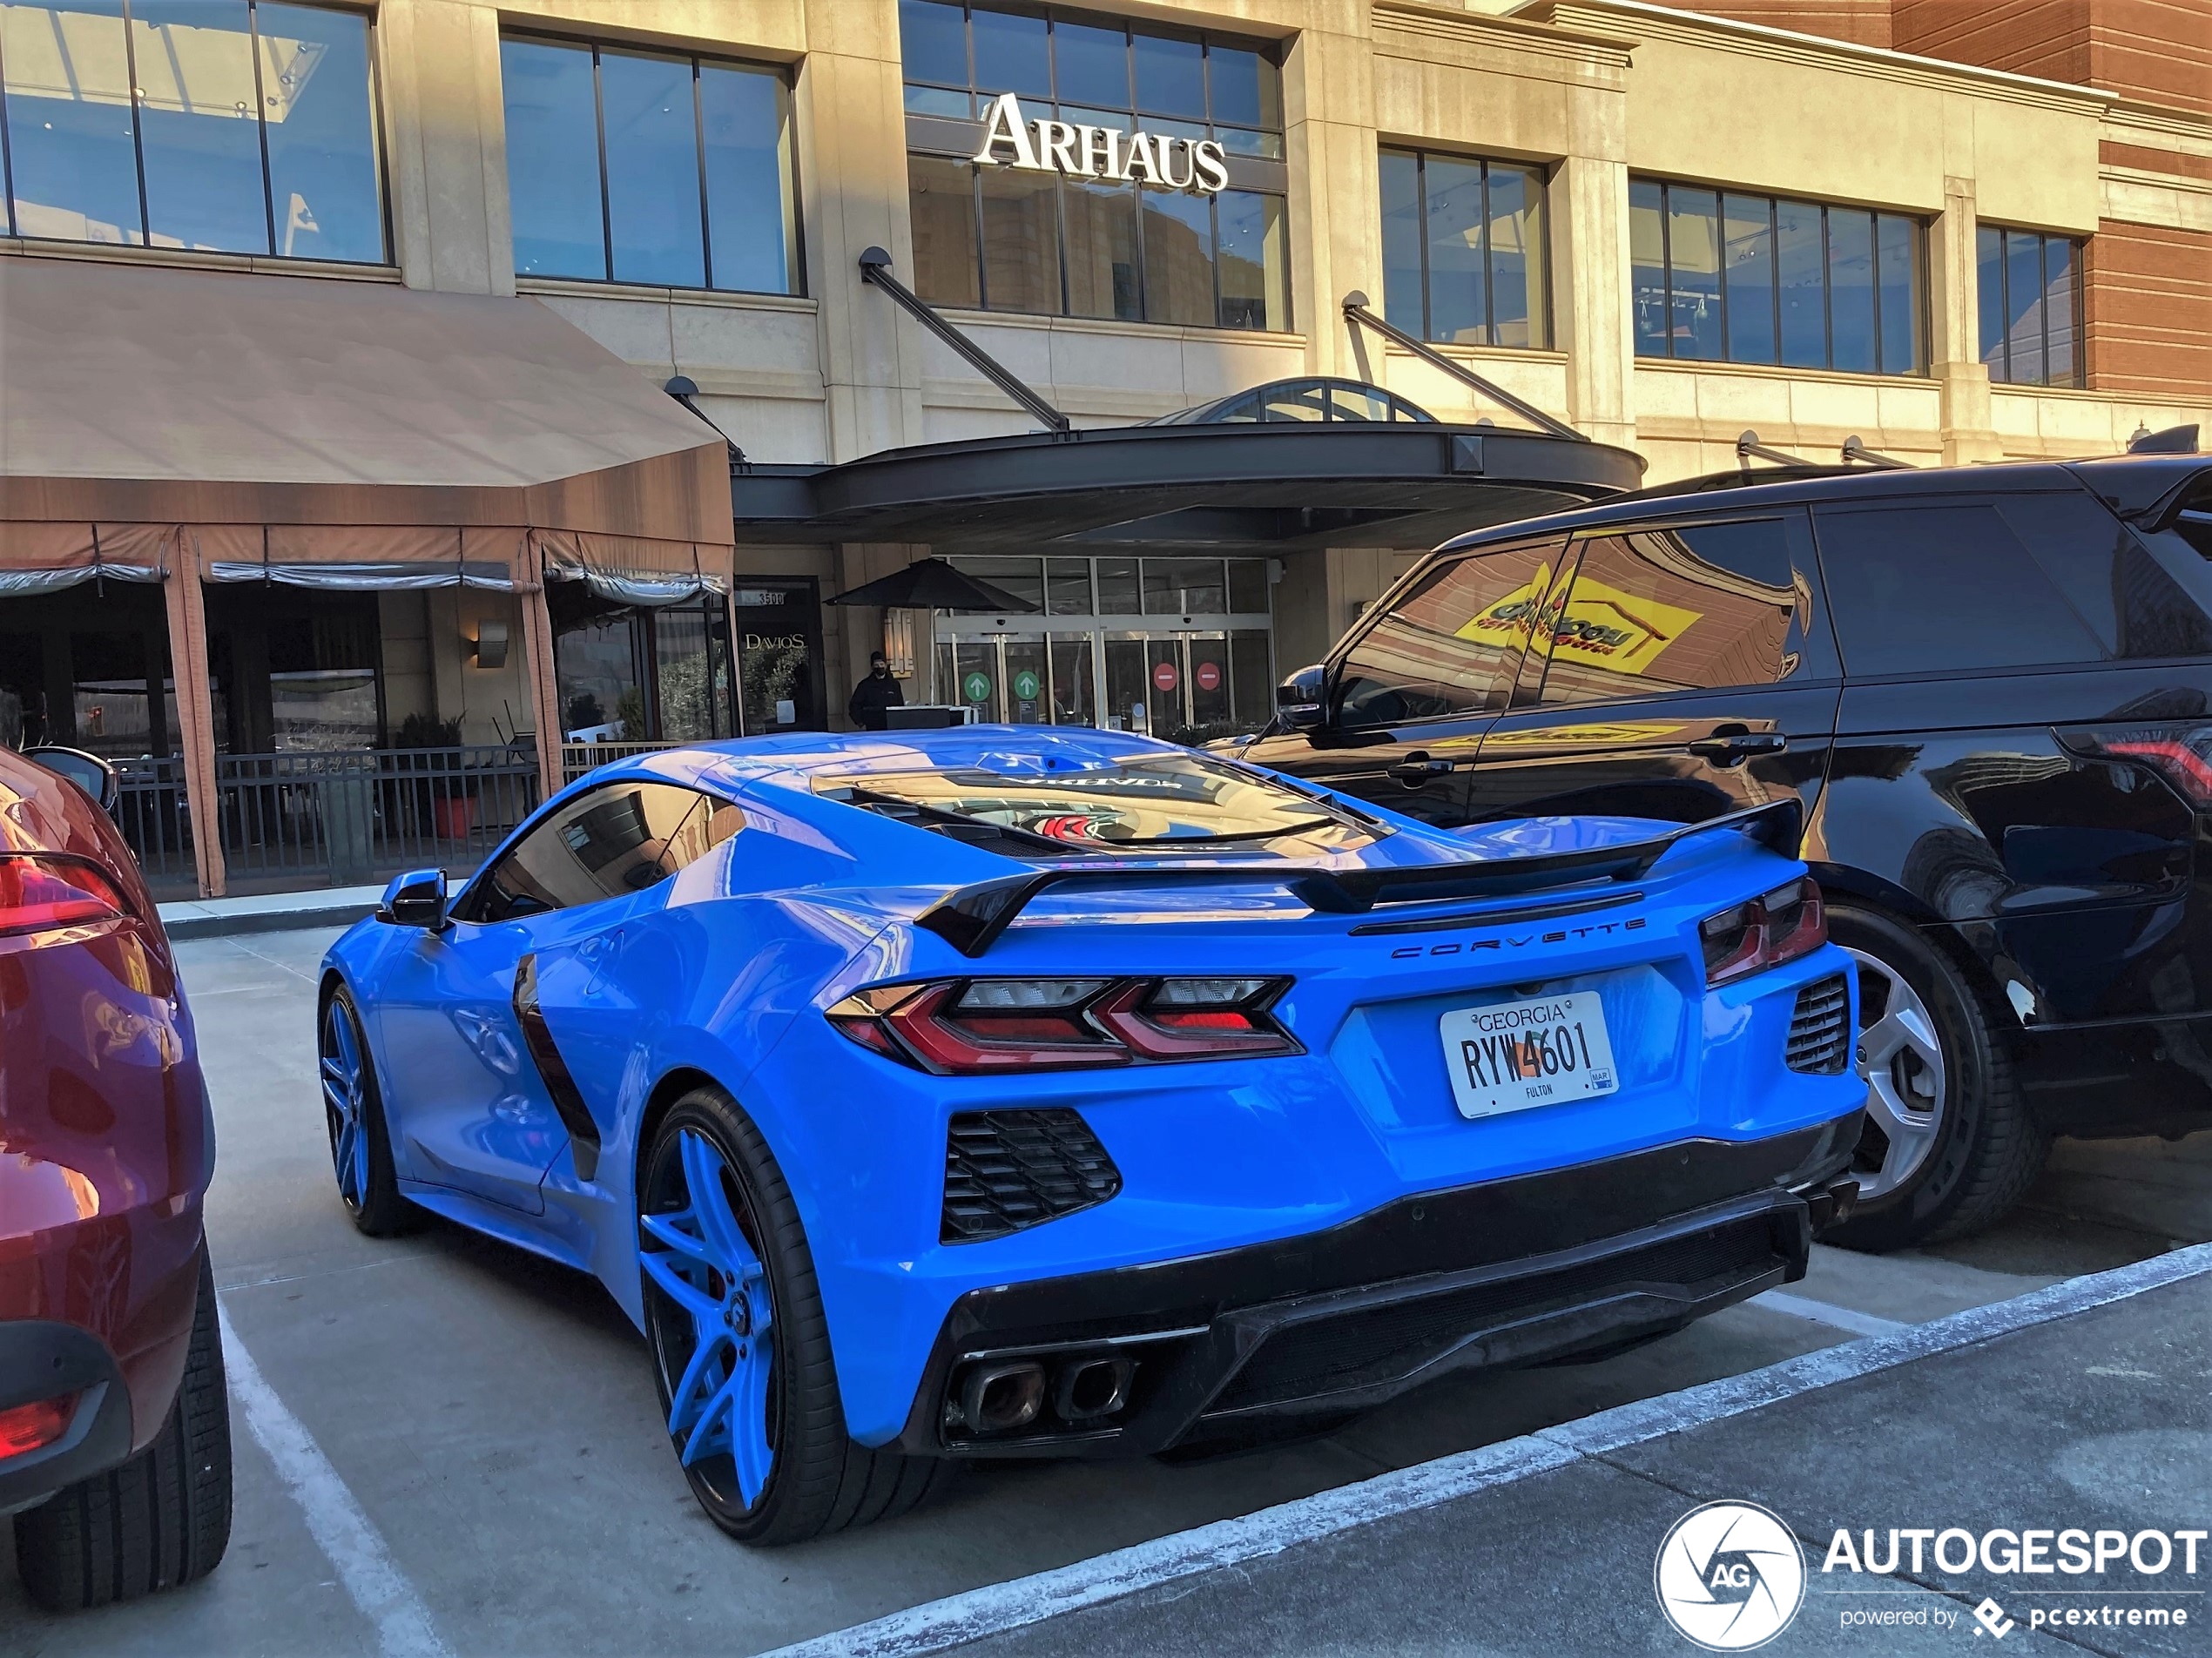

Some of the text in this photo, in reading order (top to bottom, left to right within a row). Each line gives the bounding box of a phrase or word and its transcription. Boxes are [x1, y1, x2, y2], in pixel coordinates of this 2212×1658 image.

[973, 92, 1229, 192] ARHAUS
[759, 593, 784, 604] 3500
[745, 633, 805, 650] DAVIO'S
[1392, 919, 1646, 959] CORVETTE
[1479, 1004, 1566, 1032] GEORGIA
[1461, 1022, 1592, 1088] RYW4601
[1592, 1072, 1608, 1082] MAR
[1526, 1084, 1554, 1099] FULTON
